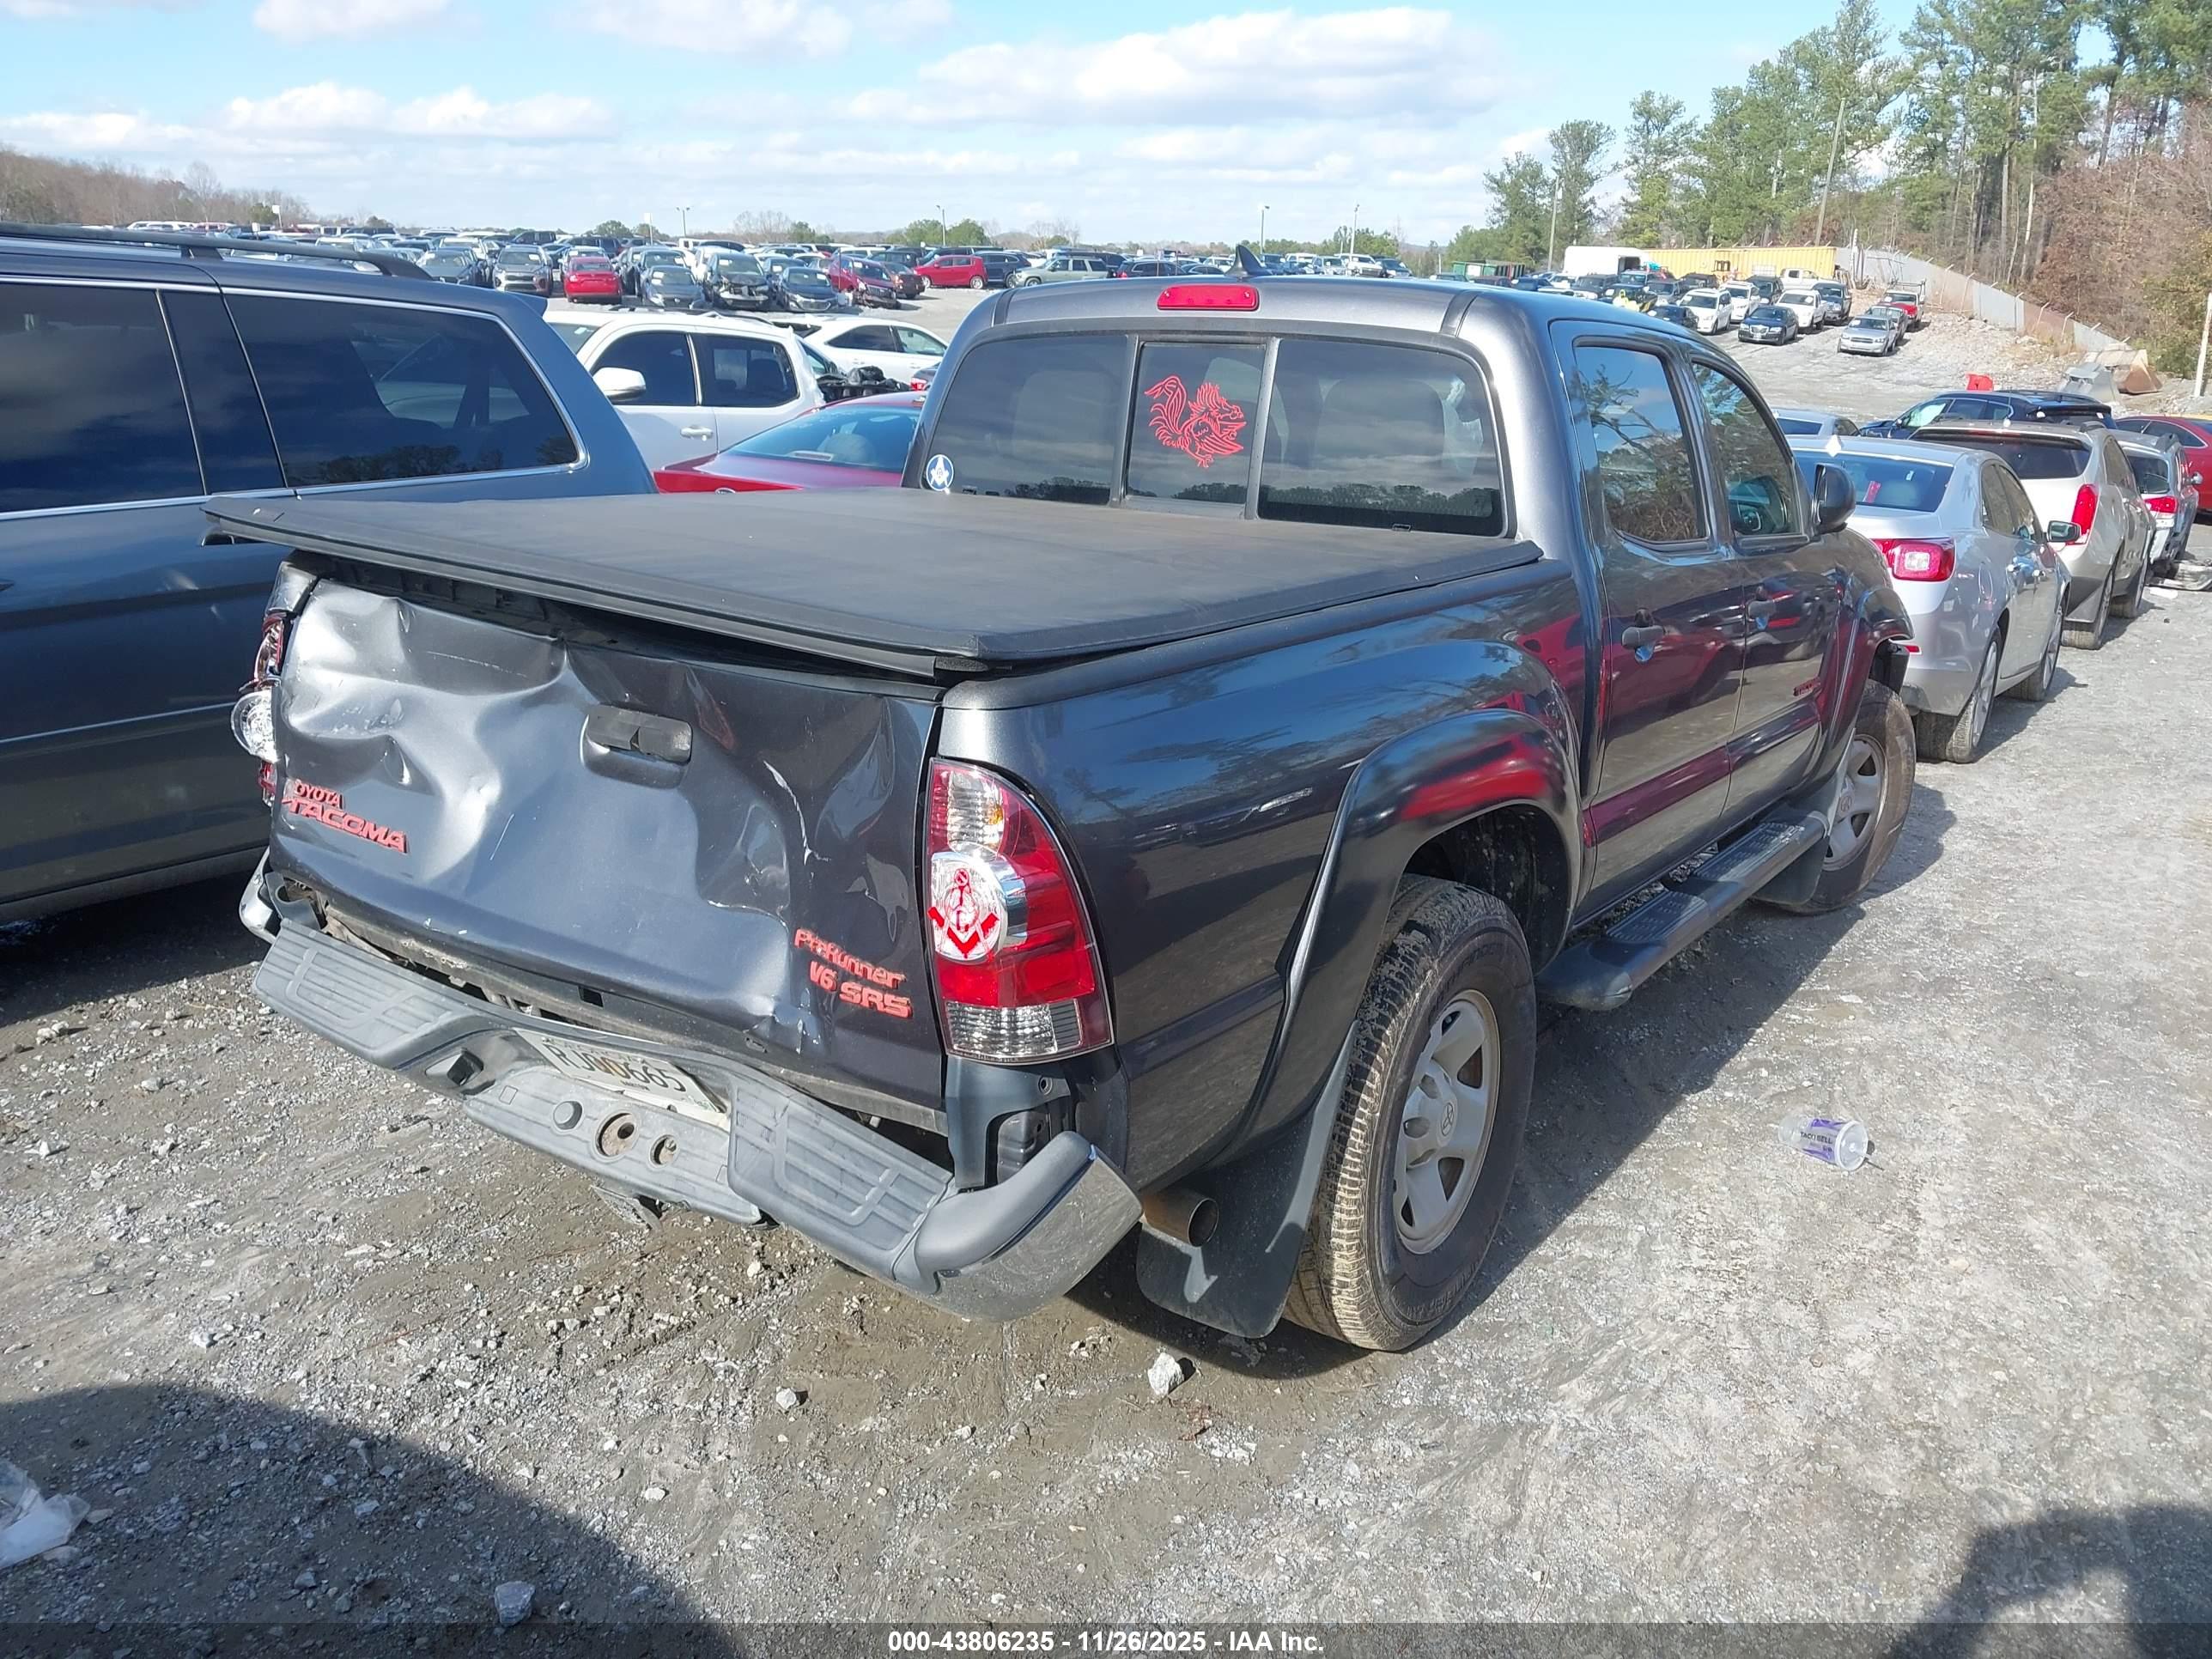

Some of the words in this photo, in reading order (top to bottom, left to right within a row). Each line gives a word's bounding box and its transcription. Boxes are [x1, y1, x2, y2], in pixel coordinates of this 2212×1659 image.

[293, 778, 343, 810] OYOTA
[282, 795, 410, 854] TACOMA
[810, 960, 837, 991] V6
[1800, 1131, 1816, 1141] TACO
[1816, 1133, 1833, 1145] BELL
